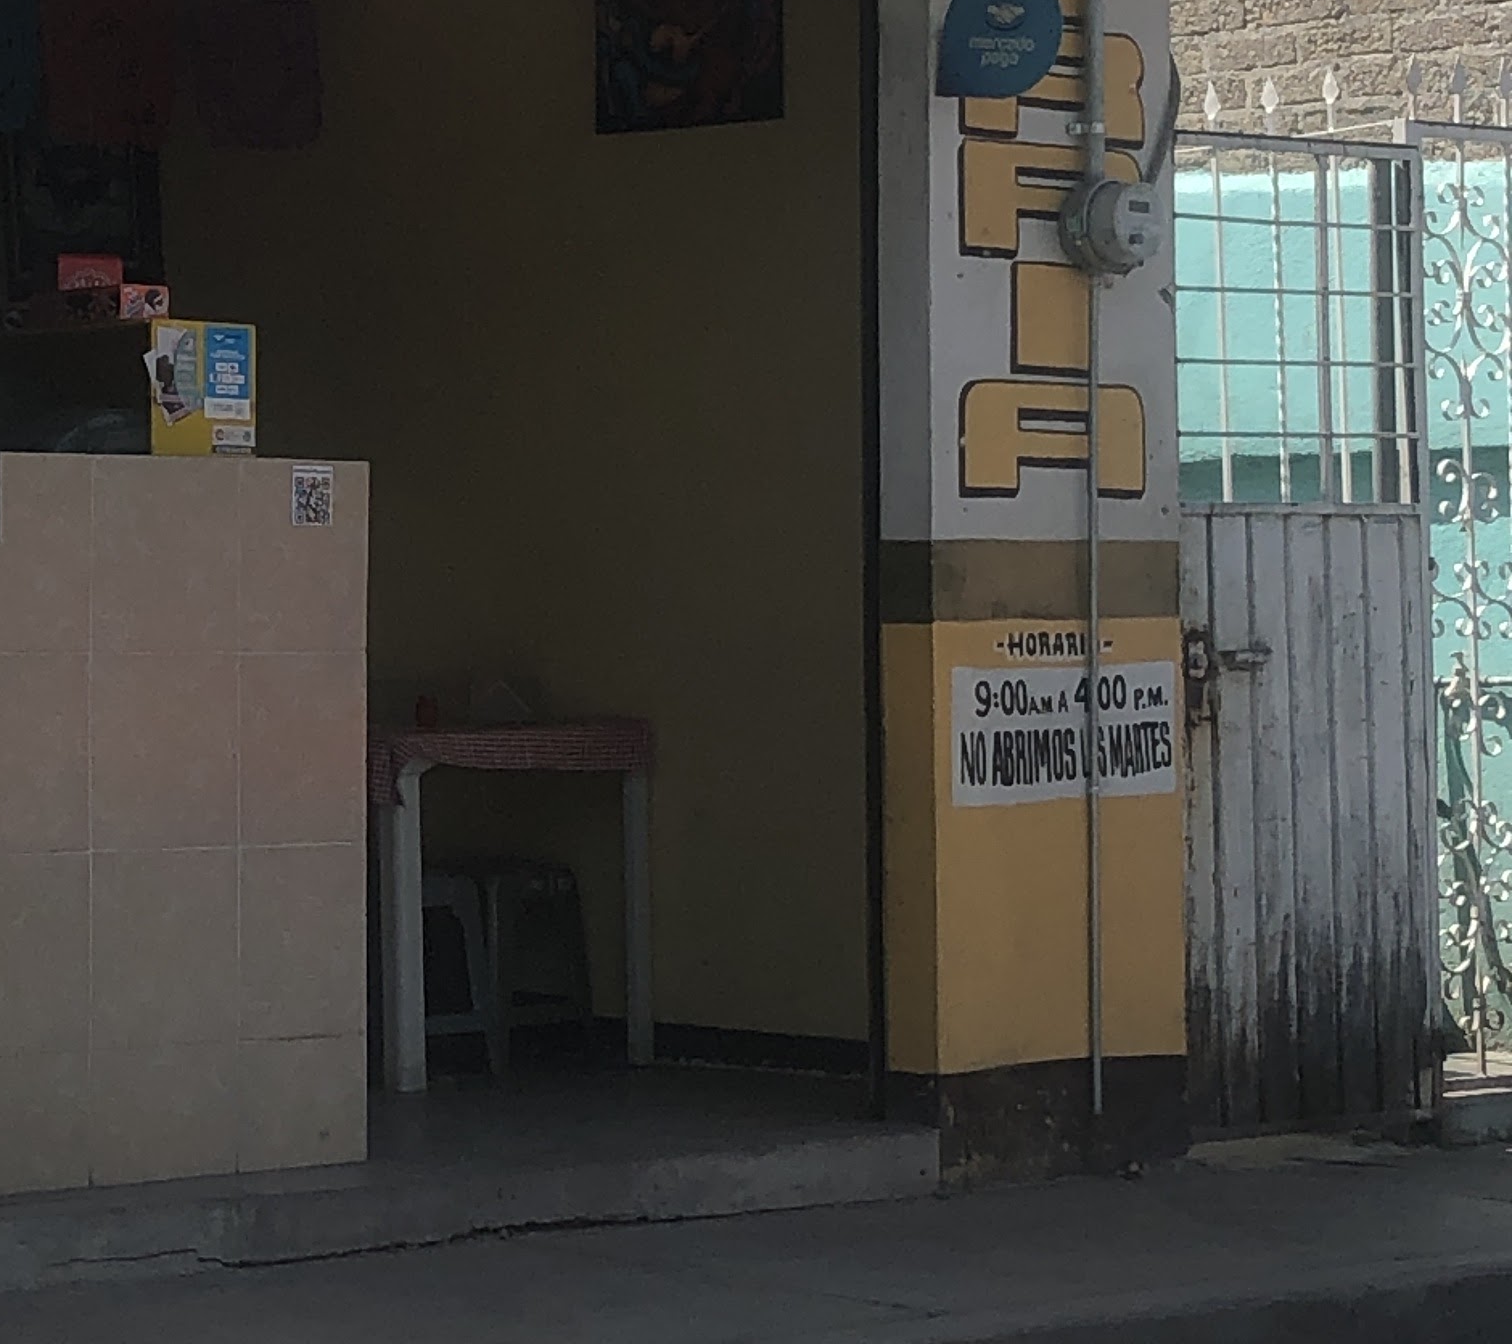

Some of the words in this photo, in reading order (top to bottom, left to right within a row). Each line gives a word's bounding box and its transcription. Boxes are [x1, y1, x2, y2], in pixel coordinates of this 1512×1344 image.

[968, 37, 1035, 52] mercado
[980, 51, 1019, 68] pago
[1058, 690, 1069, 713] A
[960, 730, 987, 787] NO
[991, 727, 1077, 787] ABRIMOS
[1080, 724, 1108, 780] LS
[1108, 721, 1172, 779] MARTES
